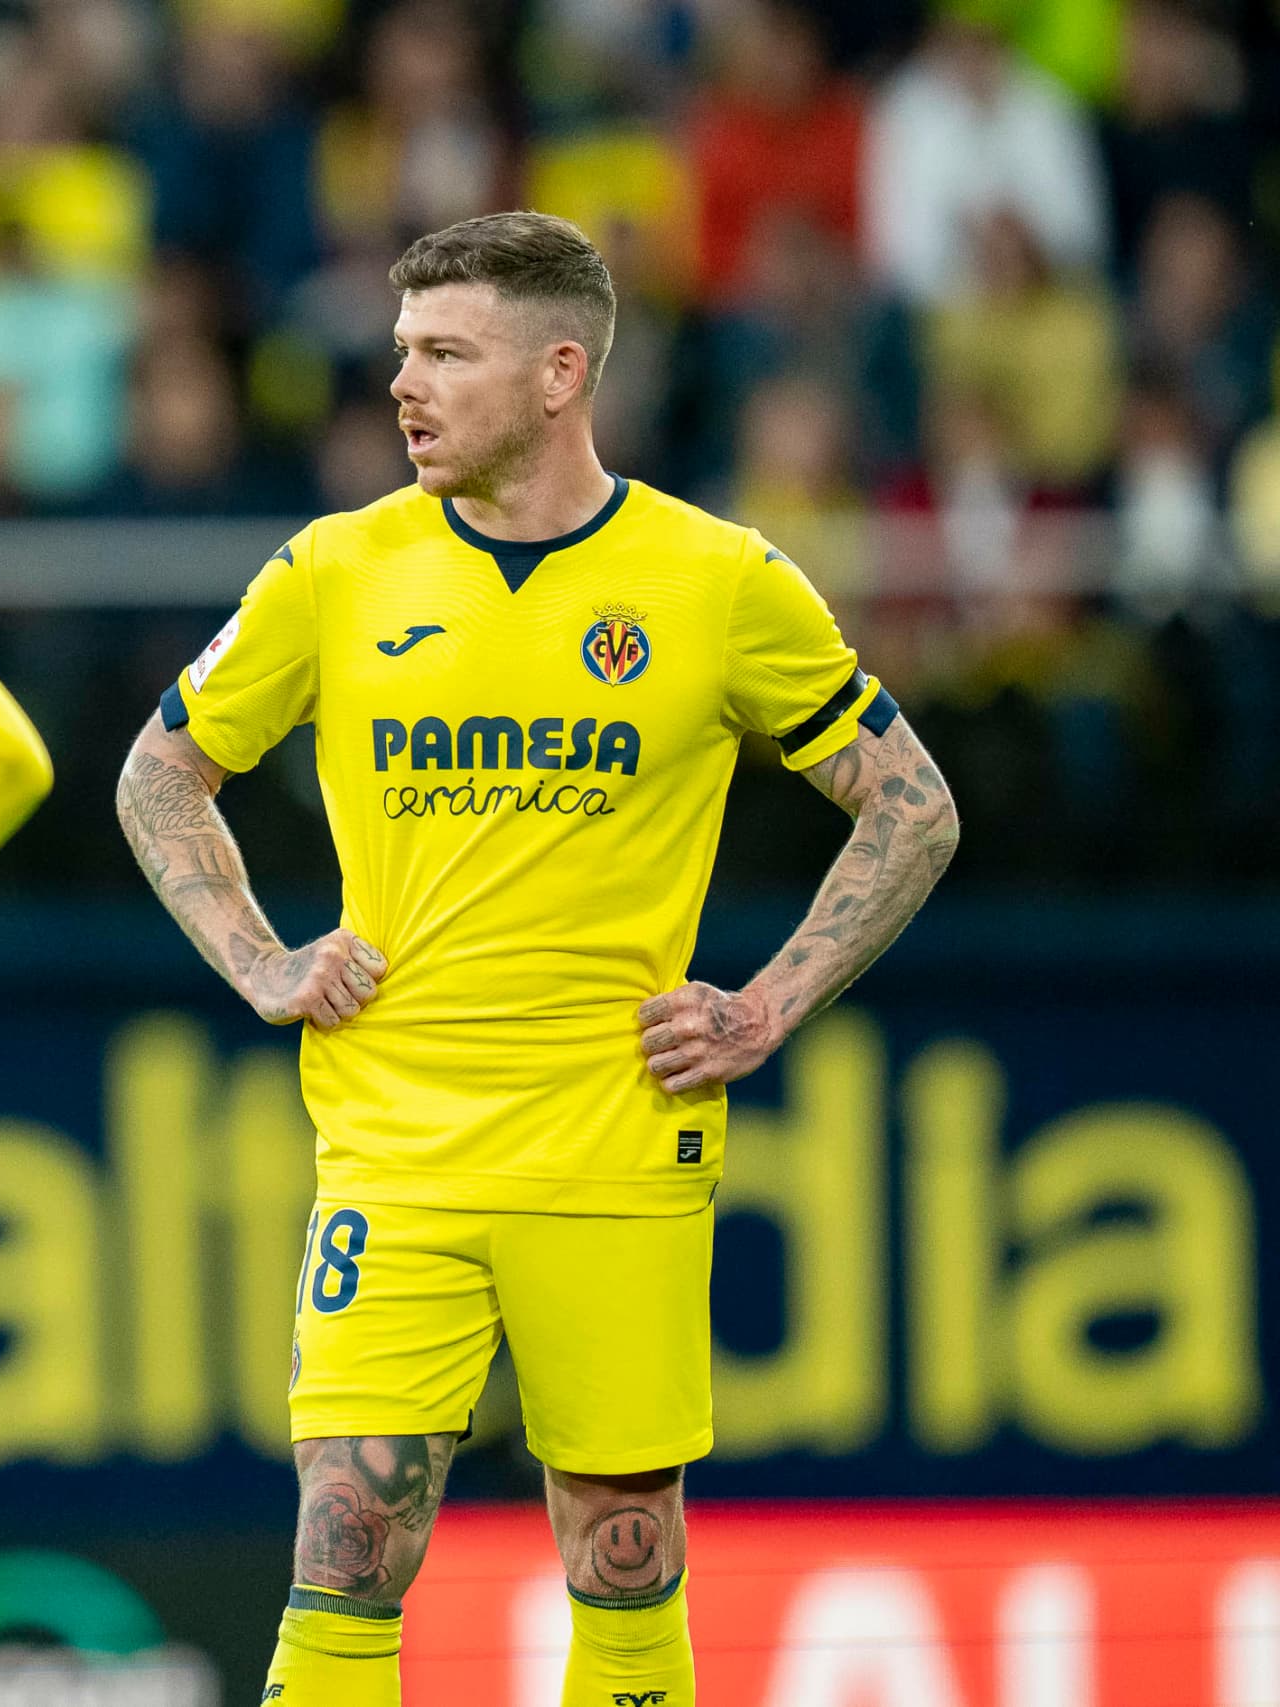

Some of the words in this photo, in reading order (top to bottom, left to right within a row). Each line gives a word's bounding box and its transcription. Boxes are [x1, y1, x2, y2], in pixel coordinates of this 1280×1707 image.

[372, 716, 641, 776] PAMESA
[383, 777, 616, 819] cerámica
[297, 1208, 369, 1314] 18
